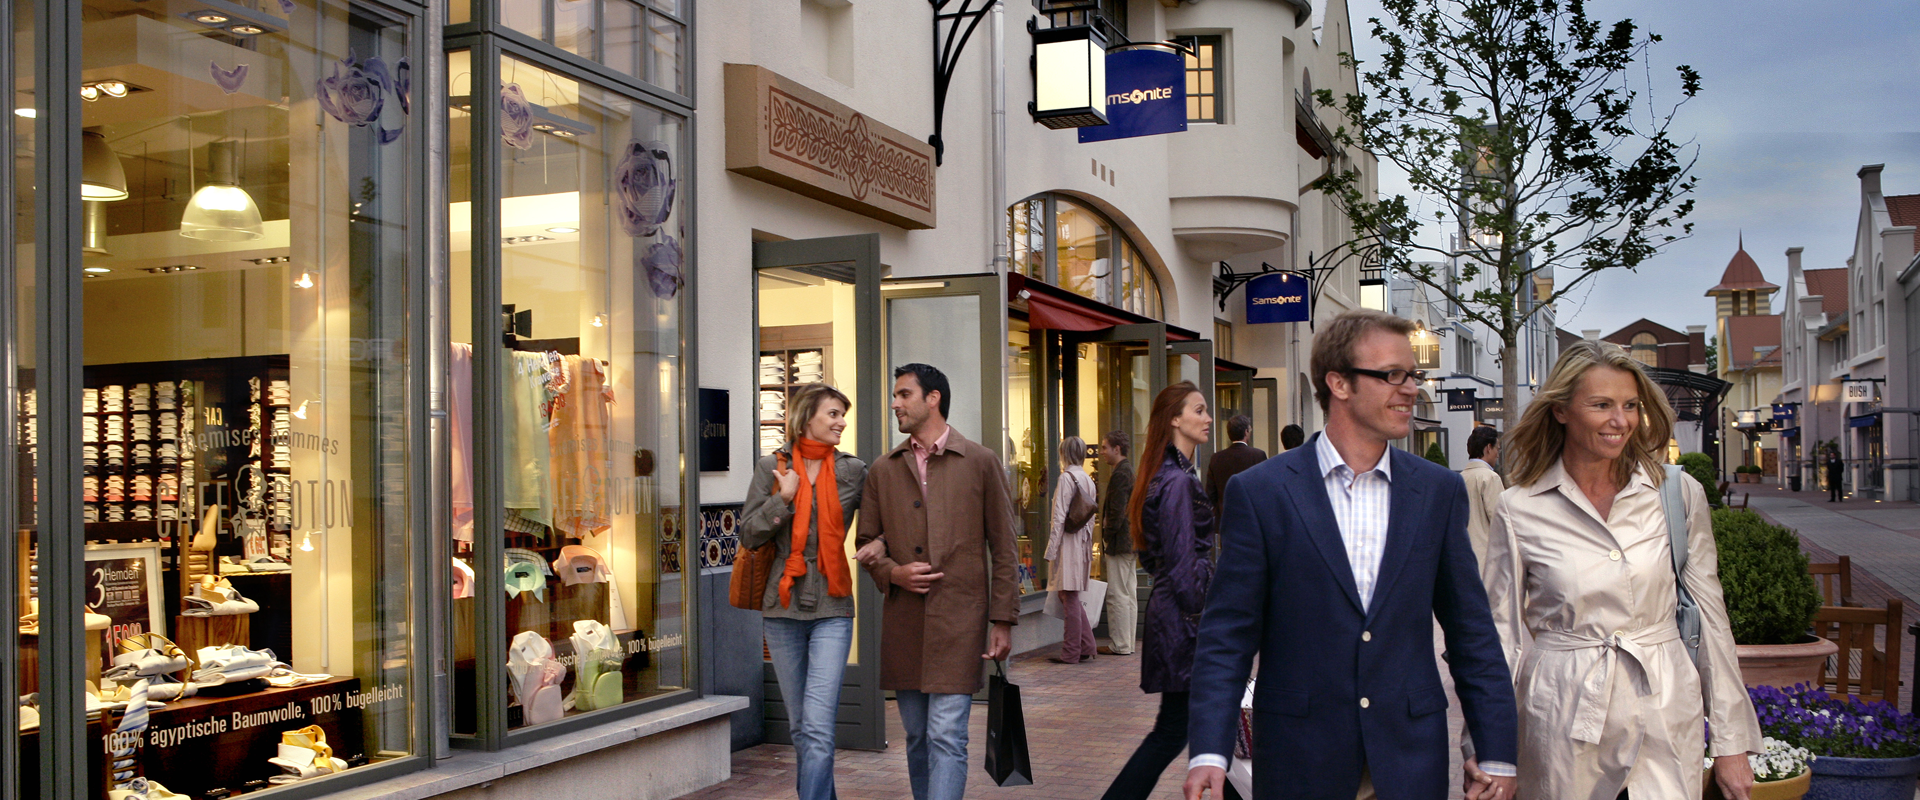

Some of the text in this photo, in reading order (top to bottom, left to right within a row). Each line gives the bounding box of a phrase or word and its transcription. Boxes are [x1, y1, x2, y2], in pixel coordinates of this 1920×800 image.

[1106, 87, 1172, 105] msonite
[1252, 295, 1302, 305] Samsonite
[529, 367, 560, 388] Krawae
[1849, 385, 1868, 398] BUSH
[174, 421, 339, 455] chemises hommes
[274, 479, 354, 531] COTON
[604, 476, 652, 516] COTON
[89, 567, 139, 609] 3 Hemden
[628, 639, 647, 655] 100%
[648, 632, 683, 652] bügelleicht
[102, 684, 403, 754] 100% ägyptische Baumwolle, 100% bügelleicht
